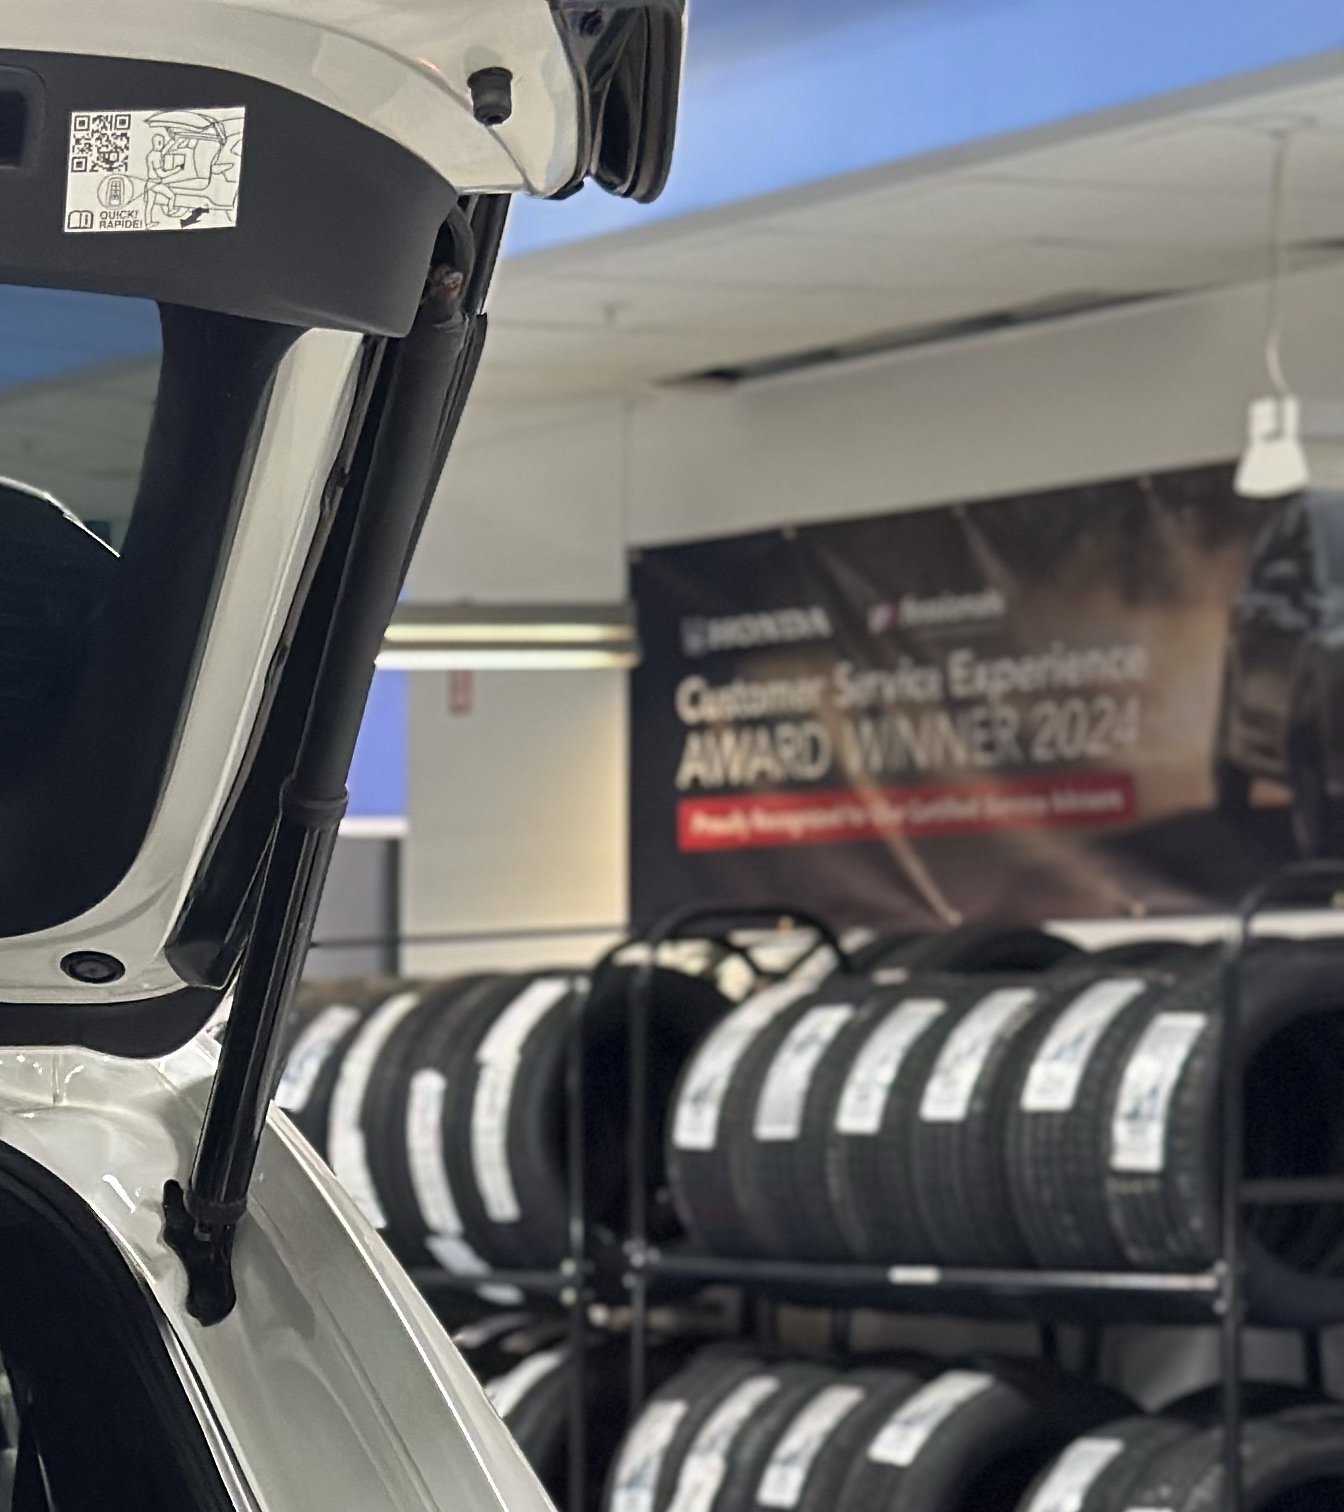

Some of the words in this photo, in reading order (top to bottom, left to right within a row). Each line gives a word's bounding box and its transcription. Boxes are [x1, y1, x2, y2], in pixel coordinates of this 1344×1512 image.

[99, 210, 138, 220] QUICK!
[99, 220, 143, 229] RAPIDE!
[708, 605, 832, 651] HONDA
[675, 675, 827, 725] Customer
[833, 659, 944, 709] Service
[947, 641, 1148, 703] Experience
[674, 719, 832, 790] AWARD
[838, 703, 1023, 778] WINNER
[1031, 697, 1140, 762] 2024
